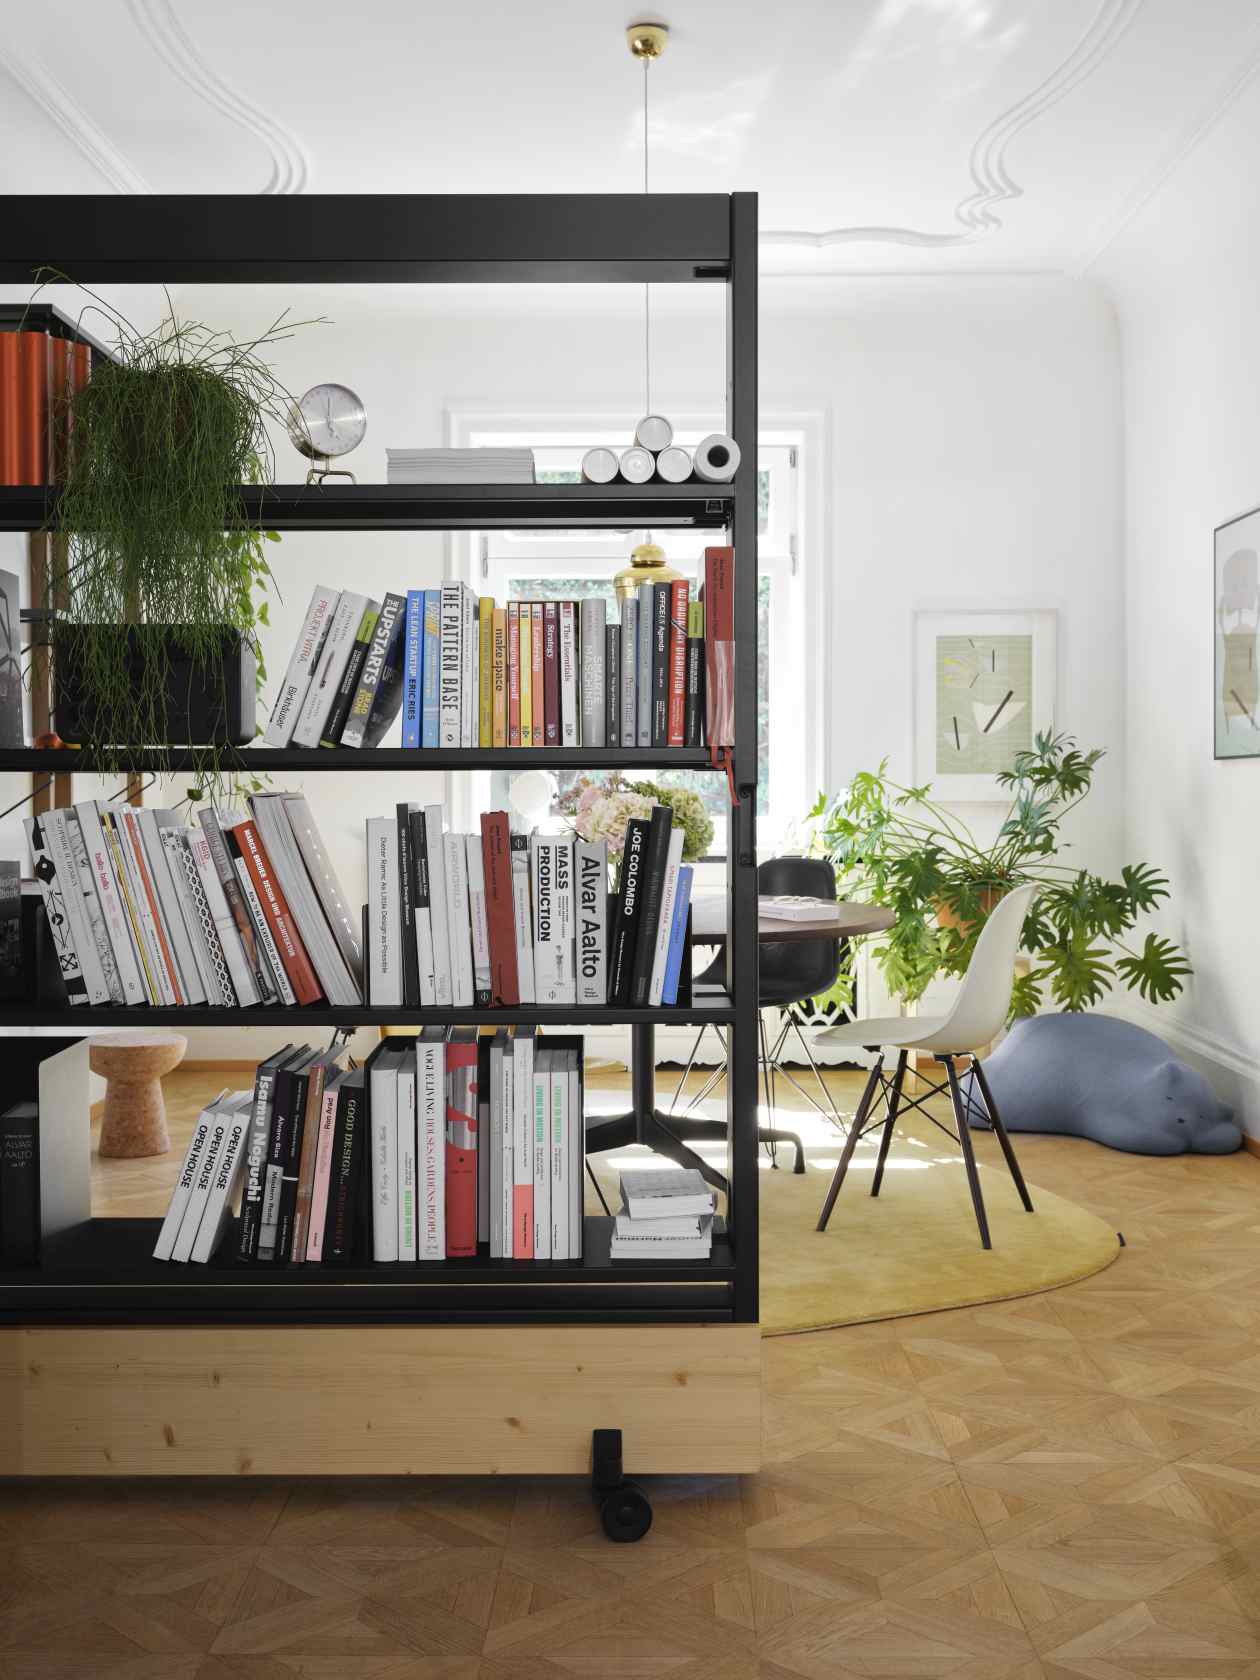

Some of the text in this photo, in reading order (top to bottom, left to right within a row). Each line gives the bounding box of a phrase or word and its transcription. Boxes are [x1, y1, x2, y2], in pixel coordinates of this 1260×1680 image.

[677, 588, 687, 599] NO
[361, 605, 398, 686] UPSTARTS
[408, 597, 420, 720] THE LEAN STARTUP ERIC RIES
[442, 586, 460, 710] THE PATTERN BASE
[492, 628, 505, 692] make space
[546, 624, 555, 658] Strategy
[512, 664, 520, 700] Yourself
[564, 642, 573, 682] Essentials
[584, 645, 593, 716] MASCHINEN
[593, 656, 602, 704] SMARTE
[674, 648, 686, 694] DISRUPTION
[380, 837, 388, 858] Dieter
[558, 845, 569, 890] MASS
[380, 882, 388, 890] As
[582, 856, 601, 914] Alvar
[624, 828, 642, 916] JOE COLOMBO
[243, 828, 295, 957] MARCEL BREUER DESIGN UND ARCHITEKTUR
[381, 892, 389, 910] Little
[540, 845, 551, 942] PRODUCTION
[378, 911, 390, 934] Design
[260, 927, 273, 953] EXPLORER
[276, 972, 288, 991] WORLD
[380, 946, 390, 974] Possible
[582, 918, 601, 978] Aalto
[424, 1048, 434, 1084] VOGUE
[323, 1096, 335, 1130] Ron Arad
[343, 1098, 357, 1131] GOOD
[425, 1086, 434, 1115] LIVING
[536, 1086, 544, 1107] LIVING
[554, 1086, 562, 1107] LIVING
[246, 1074, 274, 1202] Isamu Noguchi
[536, 1118, 544, 1142] MOTION
[554, 1118, 562, 1144] MOTION
[180, 1124, 208, 1188] OPEN HOUSE
[197, 1125, 224, 1190] OPEN HOUSE
[215, 1125, 242, 1190] OPEN HOUSE
[267, 1170, 279, 1201] Modern
[427, 1206, 437, 1240] PEOPLE
